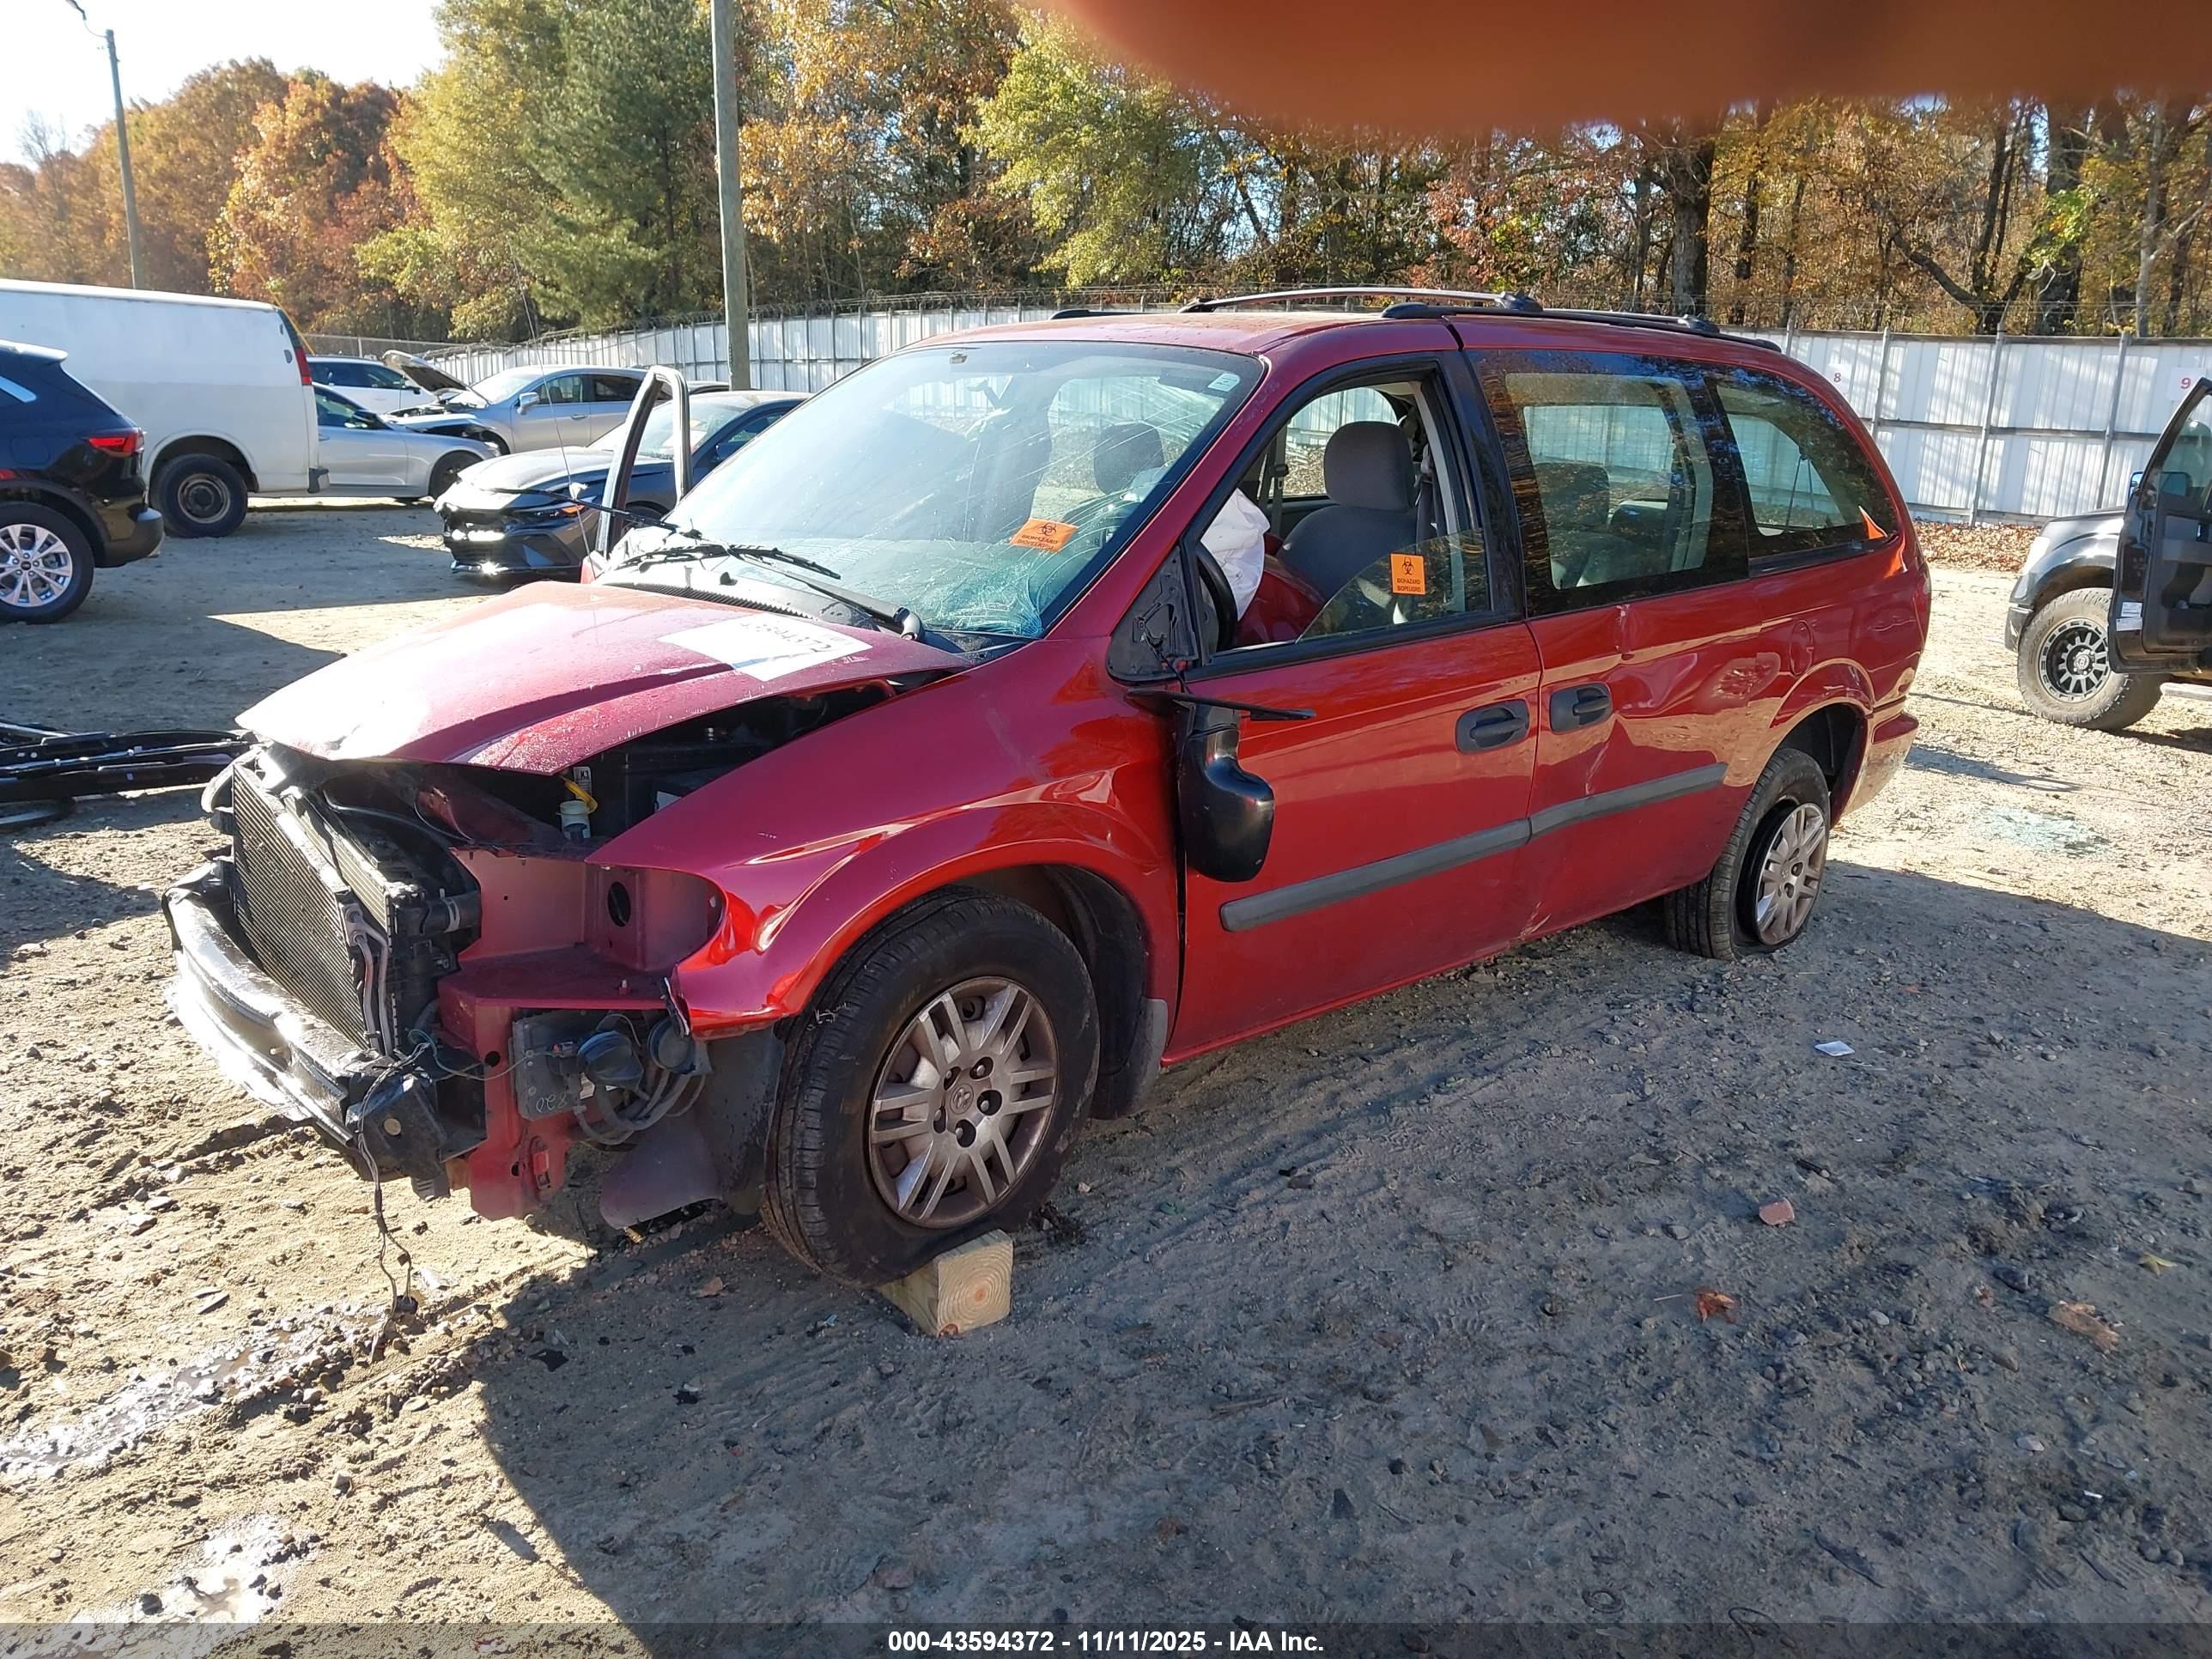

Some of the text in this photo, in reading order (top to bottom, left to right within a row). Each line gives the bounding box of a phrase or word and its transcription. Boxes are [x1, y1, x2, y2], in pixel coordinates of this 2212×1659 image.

[1833, 372, 1842, 383] 8
[2180, 377, 2191, 389] 9
[1021, 534, 1058, 544] BIOHAZARD
